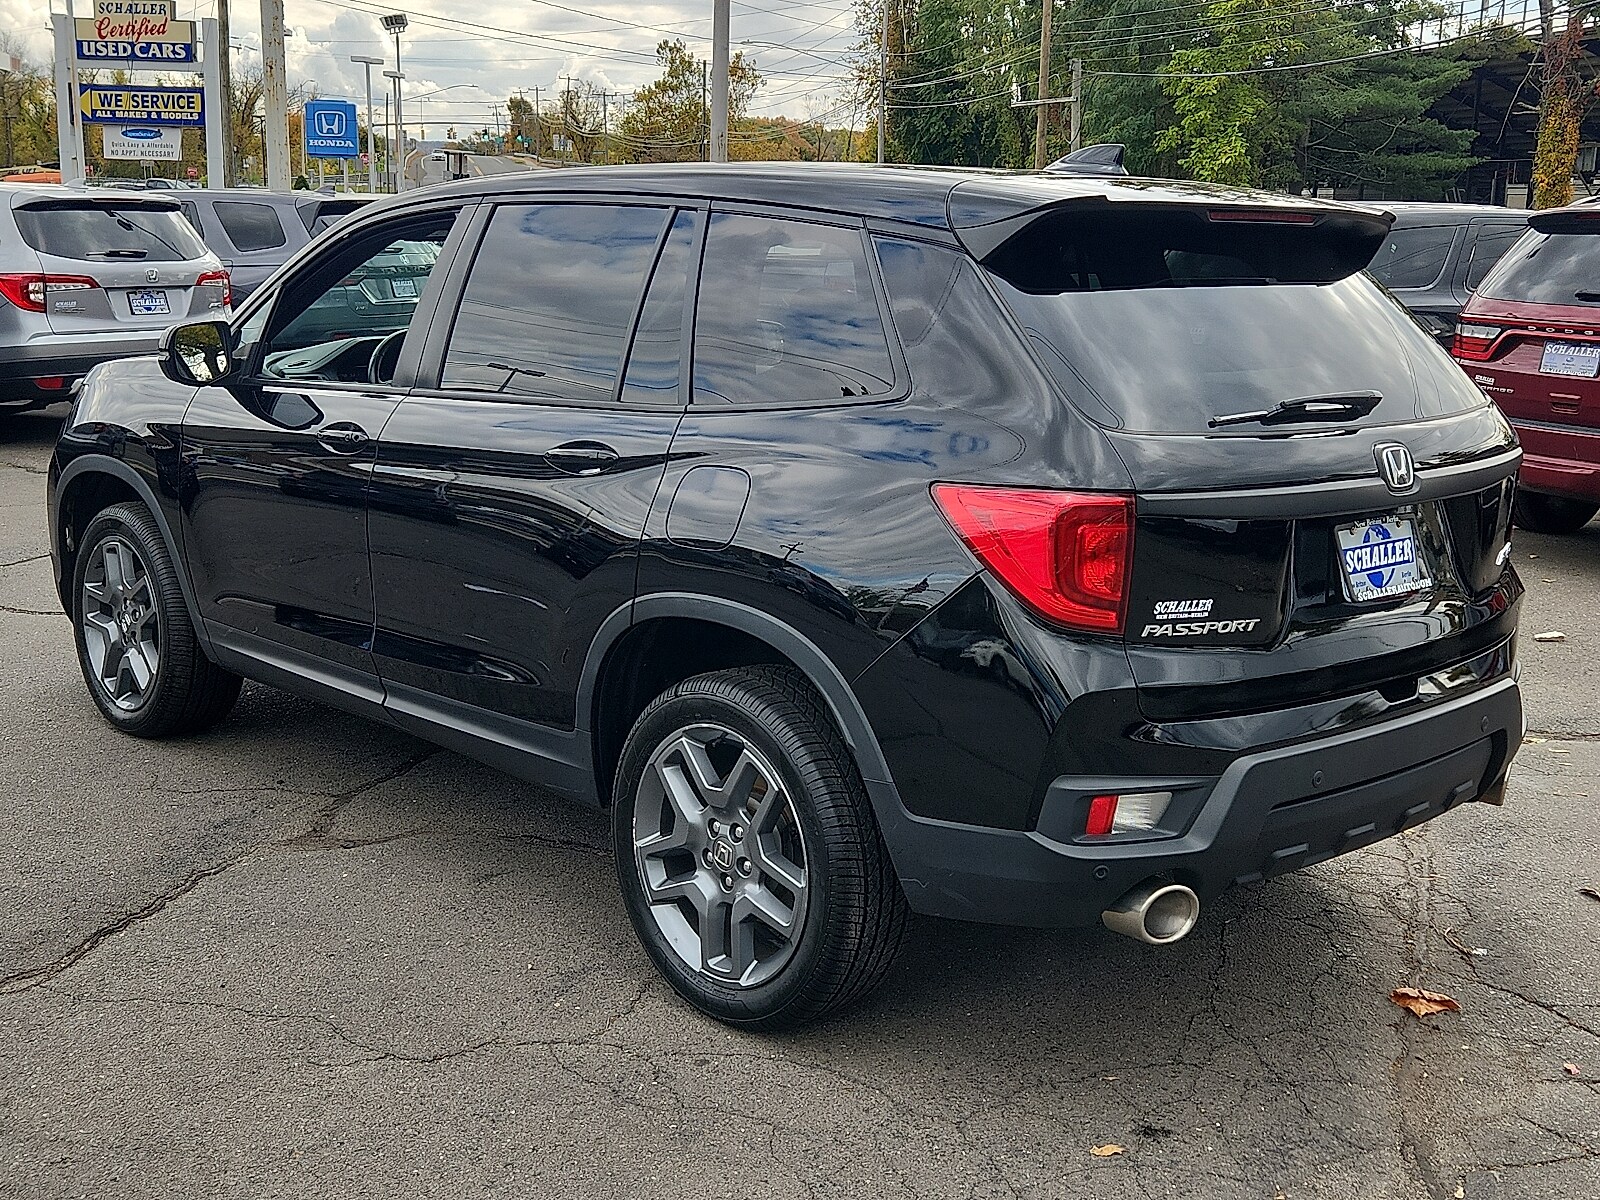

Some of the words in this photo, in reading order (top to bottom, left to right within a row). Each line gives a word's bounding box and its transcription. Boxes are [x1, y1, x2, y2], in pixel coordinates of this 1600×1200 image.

[98, 2, 167, 15] SCHALLER
[94, 17, 168, 42] Certified
[82, 41, 131, 57] USED
[134, 43, 187, 59] CARS
[97, 93, 123, 108] WE
[131, 94, 196, 110] SERVICE
[95, 110, 114, 118] ALL
[115, 110, 148, 119] MAKES
[150, 111, 158, 119] &
[161, 111, 199, 120] MODELS
[308, 139, 355, 148] HONDA
[140, 150, 175, 158] NECESSARY
[132, 299, 166, 307] SCHALLER
[1527, 325, 1594, 336] DODG
[1545, 344, 1600, 359] SCHALLER
[1345, 538, 1413, 573] SCHALLER
[1357, 577, 1433, 602] SCHALLERAUTO.COM
[1153, 598, 1214, 615] SCHALLER
[1141, 618, 1261, 638] PASSPORT
